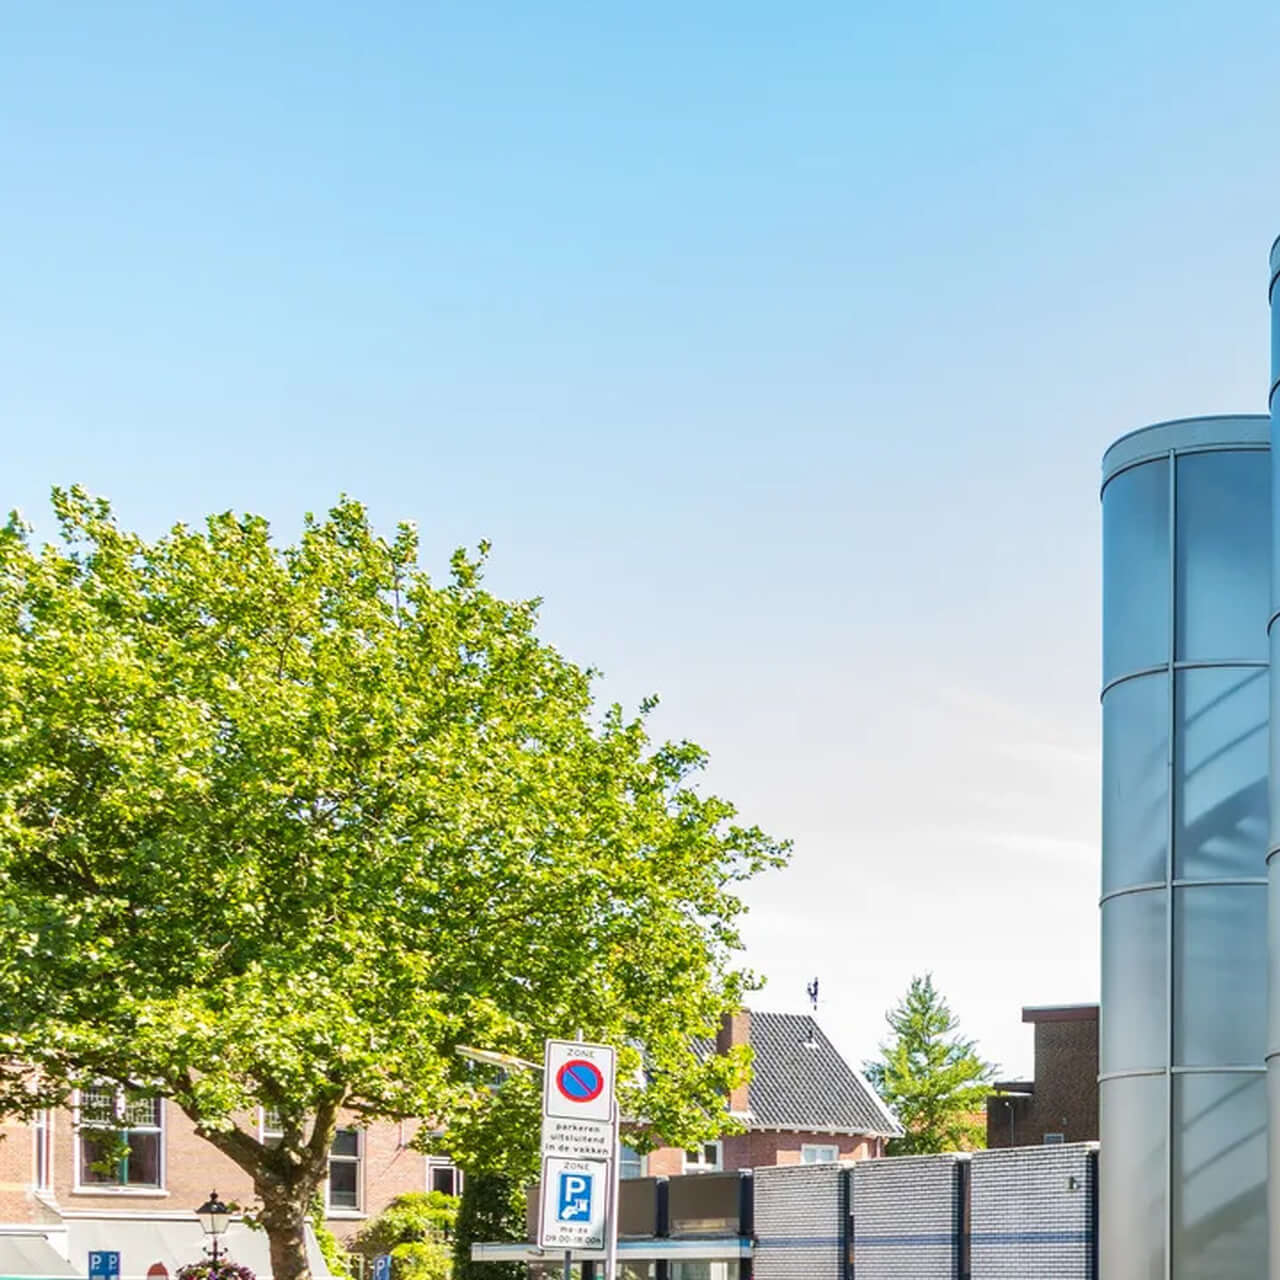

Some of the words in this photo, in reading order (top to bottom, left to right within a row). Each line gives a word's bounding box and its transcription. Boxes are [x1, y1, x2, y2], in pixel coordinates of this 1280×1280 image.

[567, 1048, 595, 1058] ZONE
[556, 1123, 601, 1133] parkeren
[550, 1133, 605, 1144] uitsluitend
[558, 1143, 570, 1152] de
[573, 1147, 609, 1155] vakken
[563, 1161, 590, 1170] ZONE
[565, 1176, 586, 1202] P
